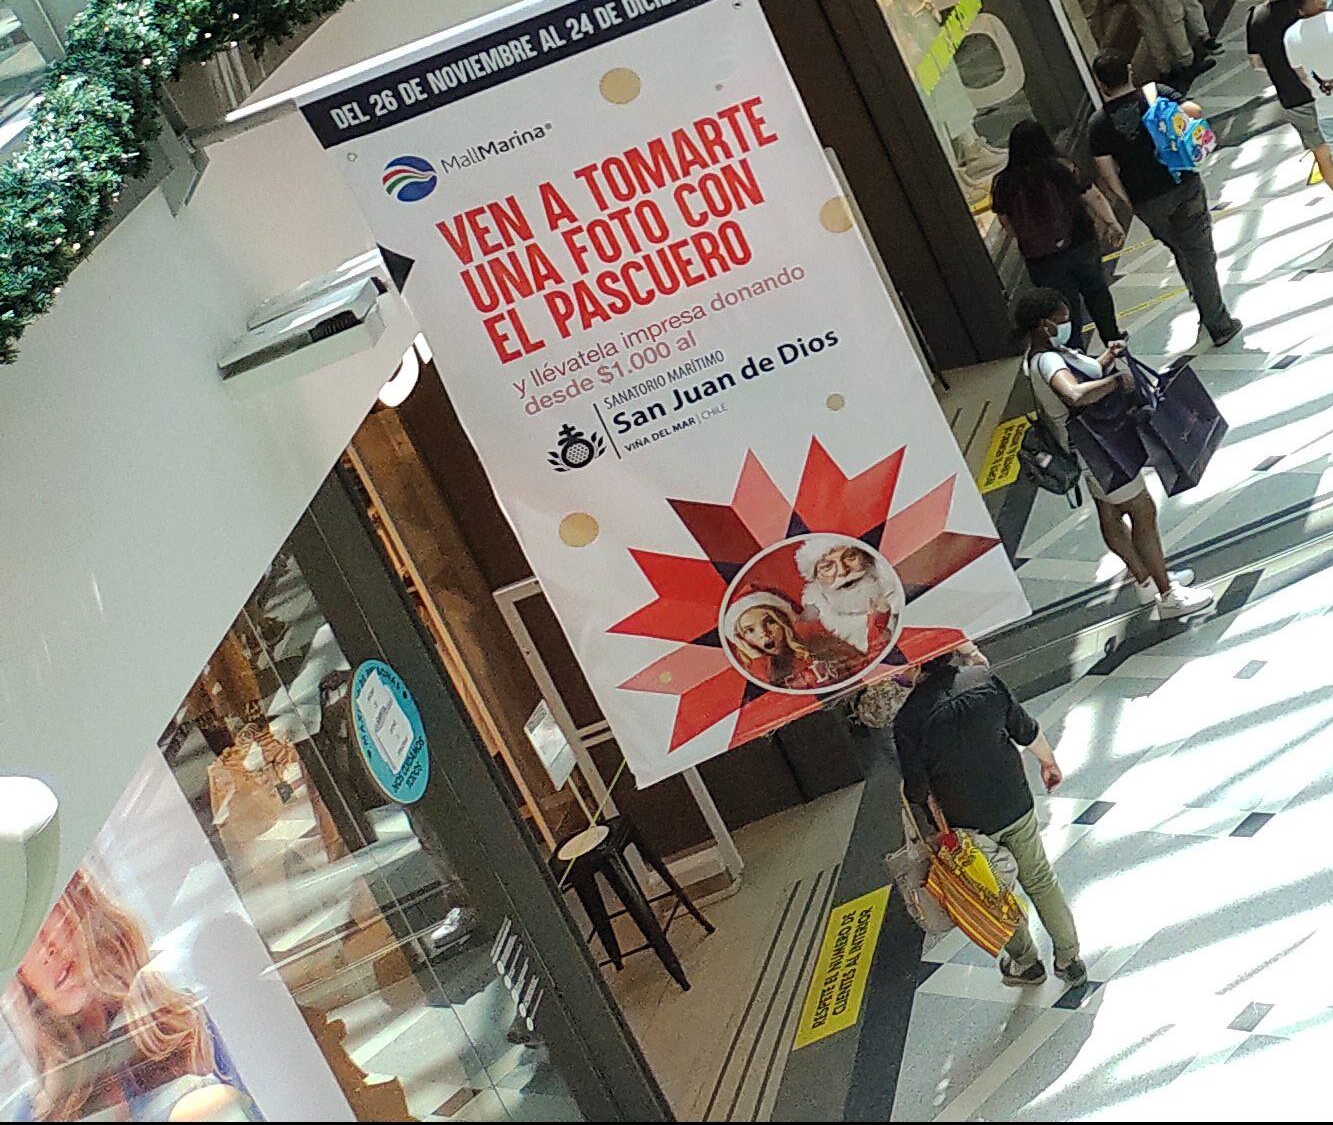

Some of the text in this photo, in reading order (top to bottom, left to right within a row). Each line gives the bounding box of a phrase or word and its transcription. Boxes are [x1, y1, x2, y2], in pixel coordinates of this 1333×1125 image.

[329, 99, 371, 130] DEL
[368, 89, 399, 119] 26
[400, 78, 428, 107] DE
[427, 35, 538, 96] NOVIEMBRE
[540, 25, 567, 53] AL
[565, 14, 596, 43] 24
[593, 2, 623, 33] DE
[435, 96, 779, 266] VEN A TOMARTE
[459, 158, 766, 314] UNA FOTO CON
[482, 220, 753, 365] EL PASCUERO
[513, 265, 805, 399] y llévatela impresa donando
[524, 329, 697, 416] desde $1.000 al
[603, 349, 725, 410] SANATORIO MARÍTIMO
[612, 328, 839, 435] San Juan de Dios
[624, 402, 728, 453] VIÑA DEL MAR CHILE
[812, 984, 834, 1029] RESPETE
[824, 971, 840, 987] EL
[840, 910, 857, 926] DE
[832, 904, 874, 1016] CLIENTES AL INTERIOR
